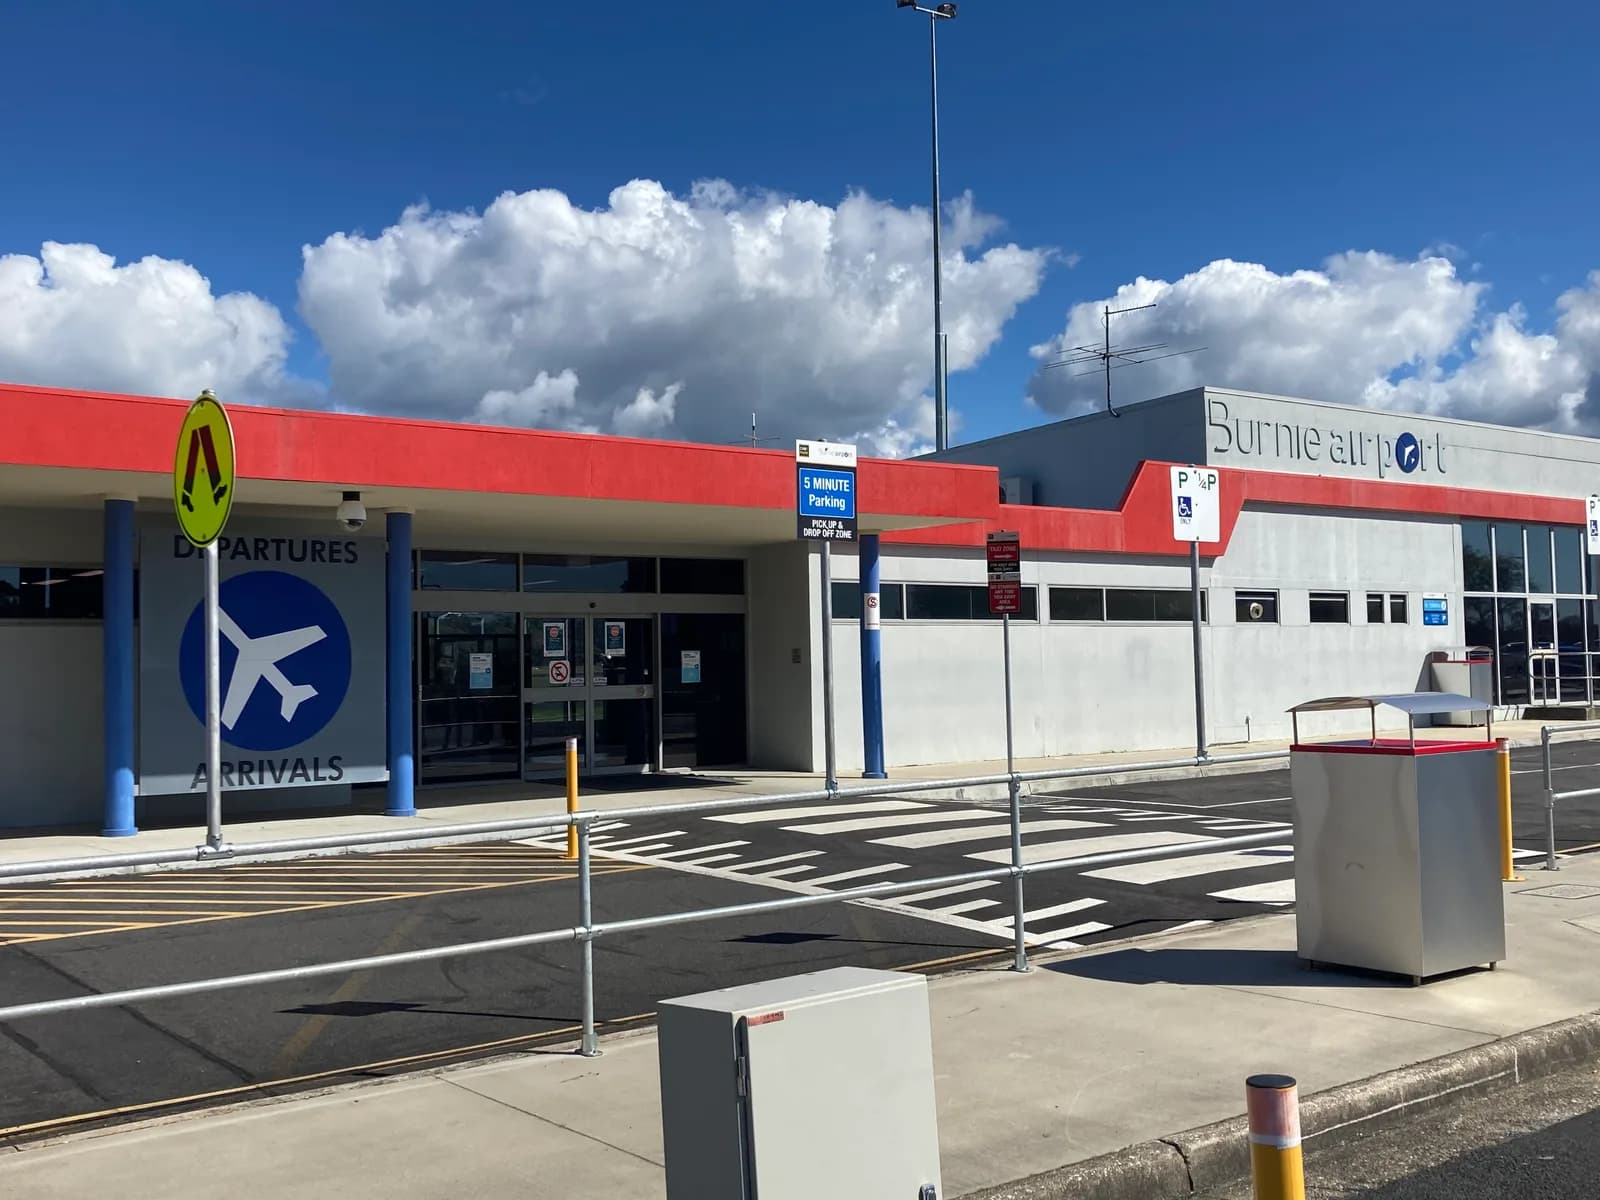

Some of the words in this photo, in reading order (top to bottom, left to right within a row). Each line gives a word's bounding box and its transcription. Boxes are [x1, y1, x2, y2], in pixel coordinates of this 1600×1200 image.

[1207, 398, 1321, 461] Burnie
[1330, 430, 1447, 479] airport
[804, 477, 810, 489] 5
[813, 477, 850, 492] MINUTE
[1178, 471, 1188, 488] P
[809, 494, 846, 511] Parking
[812, 520, 827, 529] PICK
[828, 520, 837, 529] UP
[838, 521, 843, 529] &
[803, 528, 821, 537] DROP
[822, 529, 835, 538] OFF
[835, 530, 852, 539] ZONE
[174, 534, 358, 564] DPARTURES
[190, 755, 344, 790] ARRIVALS
